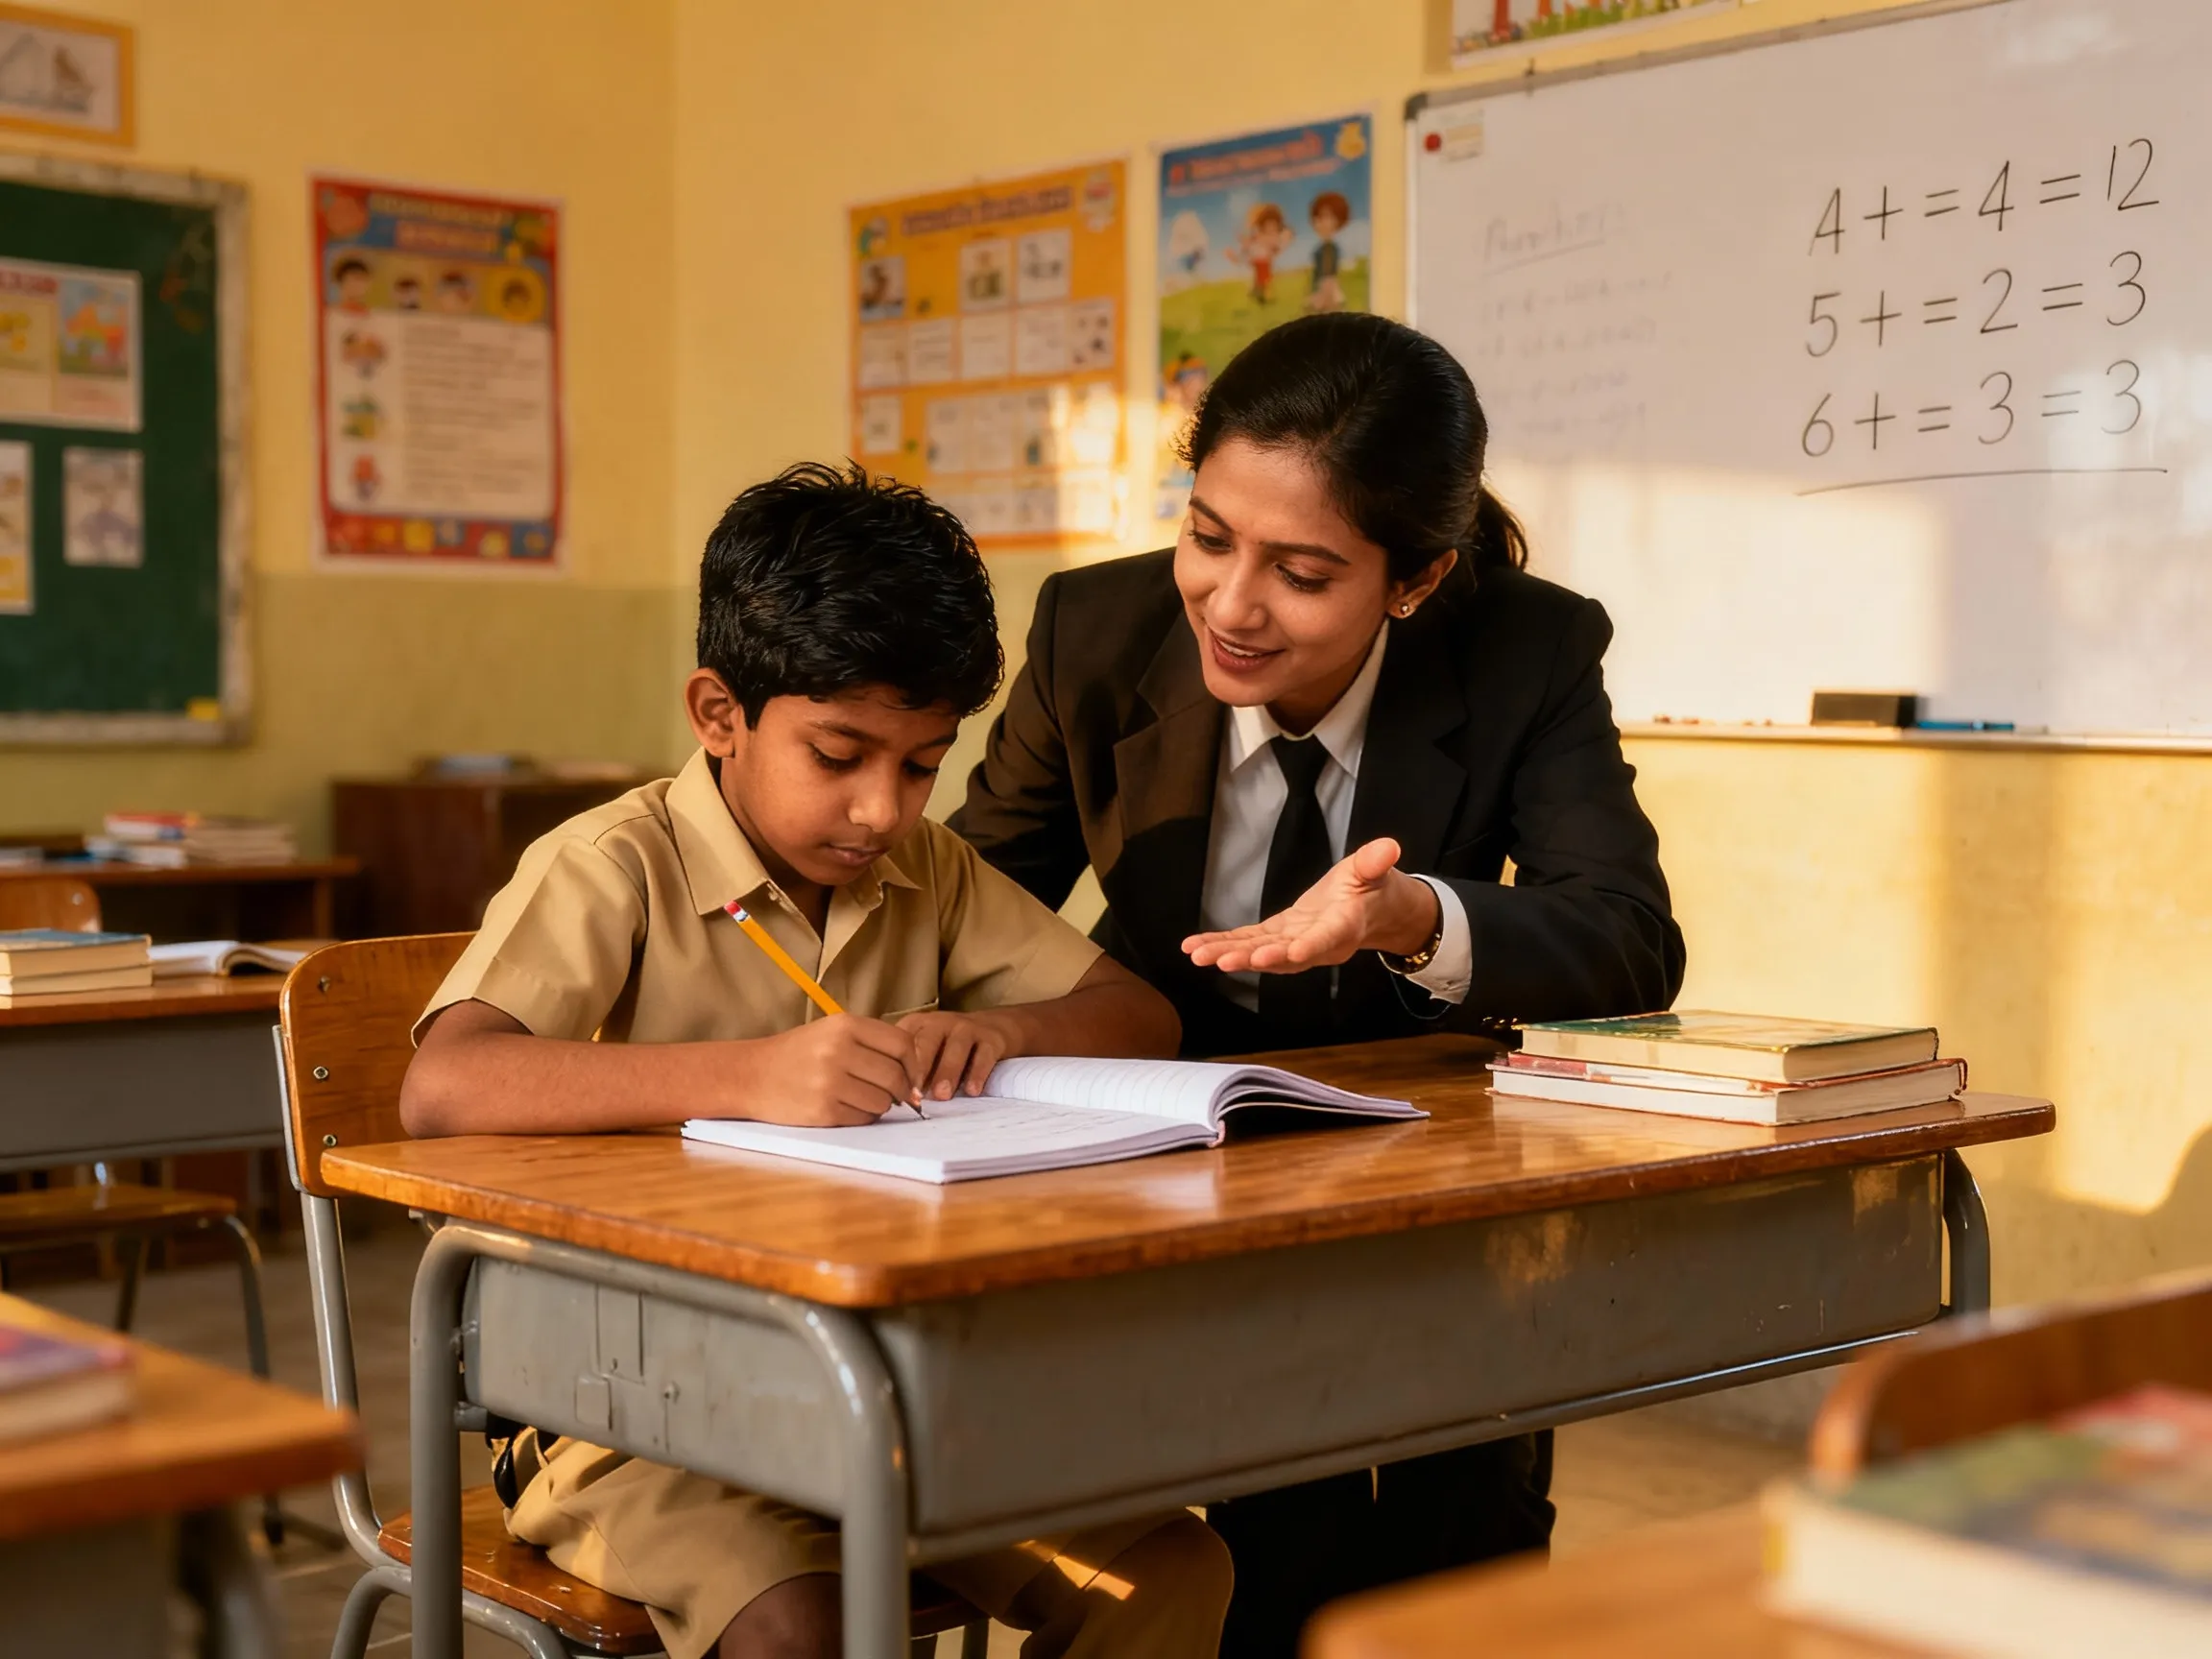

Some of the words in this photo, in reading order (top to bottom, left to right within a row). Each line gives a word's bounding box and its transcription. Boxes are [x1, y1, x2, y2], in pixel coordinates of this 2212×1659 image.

[1863, 184, 1905, 241] +
[1924, 188, 1960, 218] =
[1978, 159, 2015, 231] 4
[2039, 173, 2082, 204] =
[2106, 137, 2160, 211] 12
[1807, 291, 1842, 358] 5
[1859, 289, 1903, 348] +
[1923, 297, 1959, 325] =
[1980, 267, 2019, 335] 2
[2041, 282, 2084, 312] =
[2106, 250, 2147, 326] 3
[1801, 392, 1835, 458] 6
[1853, 391, 1897, 451] +
[1917, 404, 1953, 433] =
[1978, 371, 2014, 445] 3
[2041, 390, 2082, 418] =
[2101, 359, 2142, 435] 3
